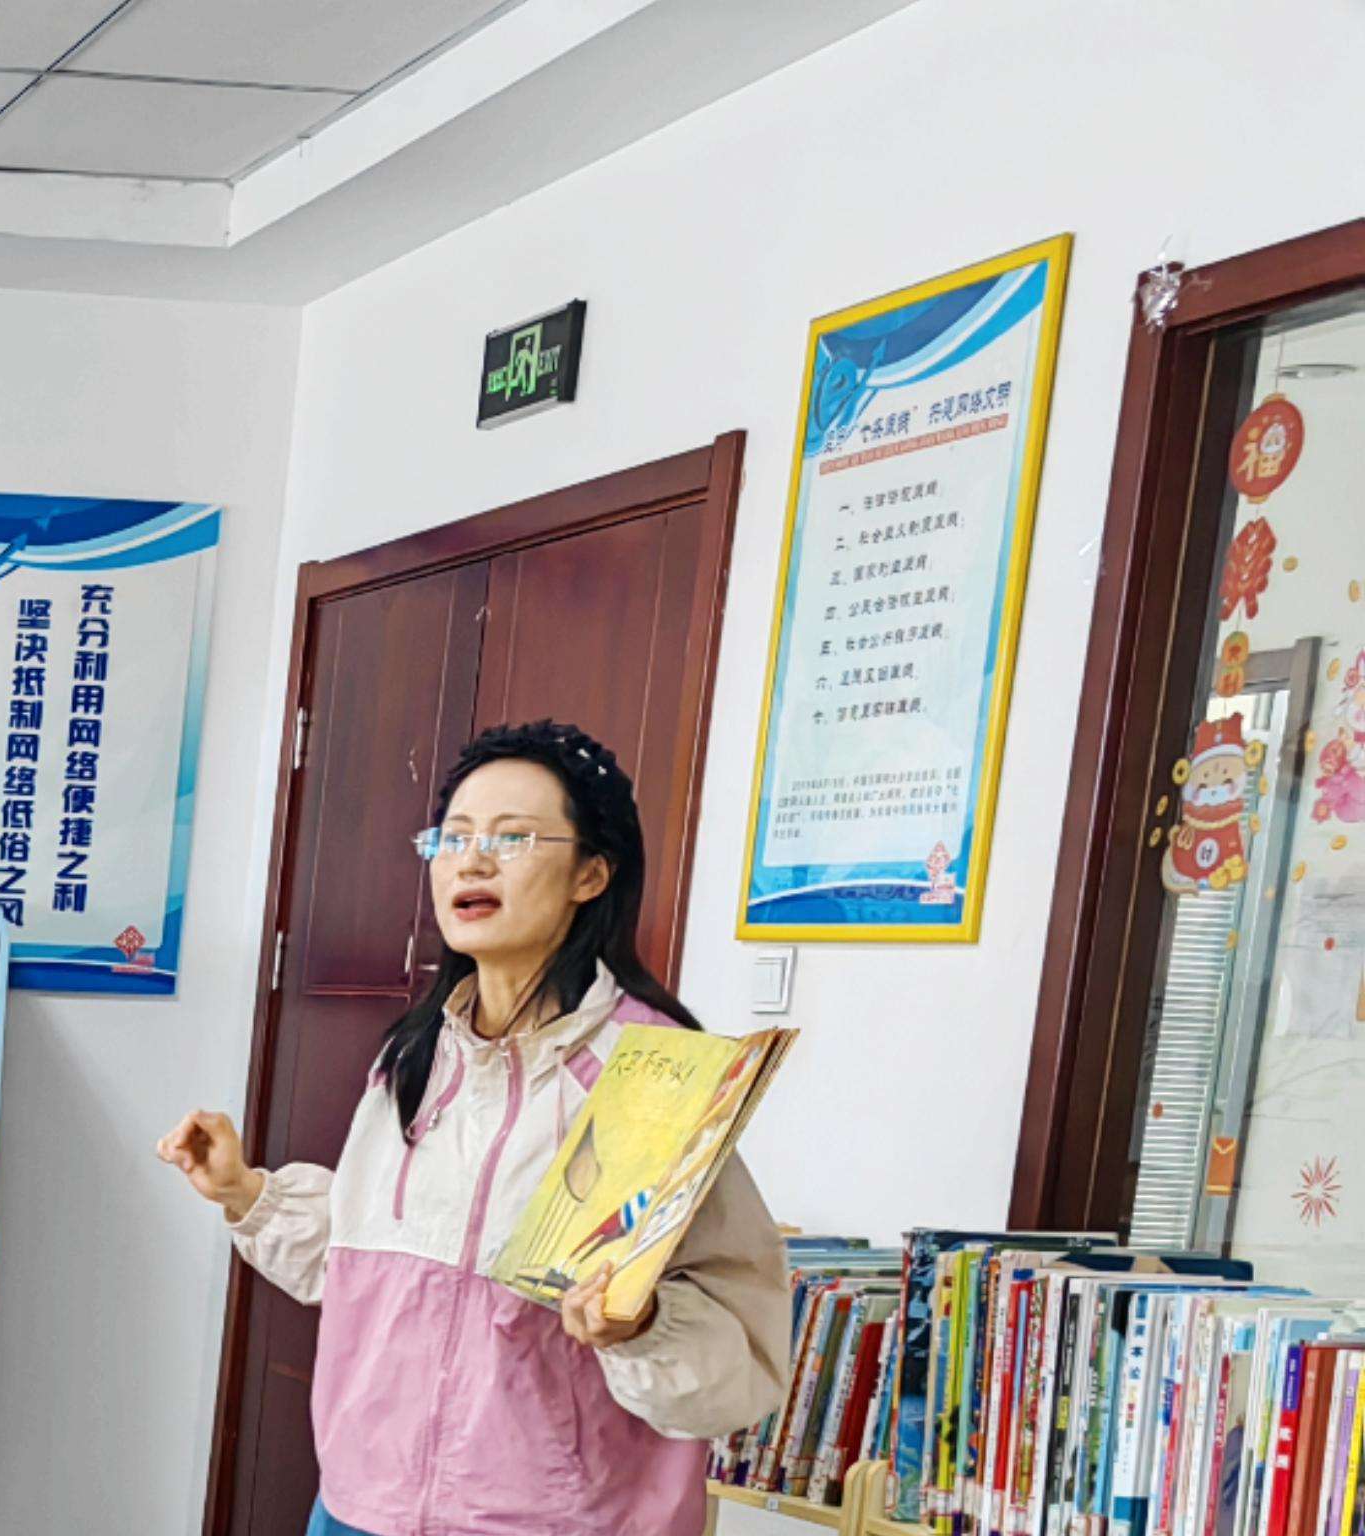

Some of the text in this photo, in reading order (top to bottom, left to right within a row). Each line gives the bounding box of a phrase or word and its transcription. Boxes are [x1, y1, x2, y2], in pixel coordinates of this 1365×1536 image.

[52, 584, 114, 913] 充分利用网络便捷之利
